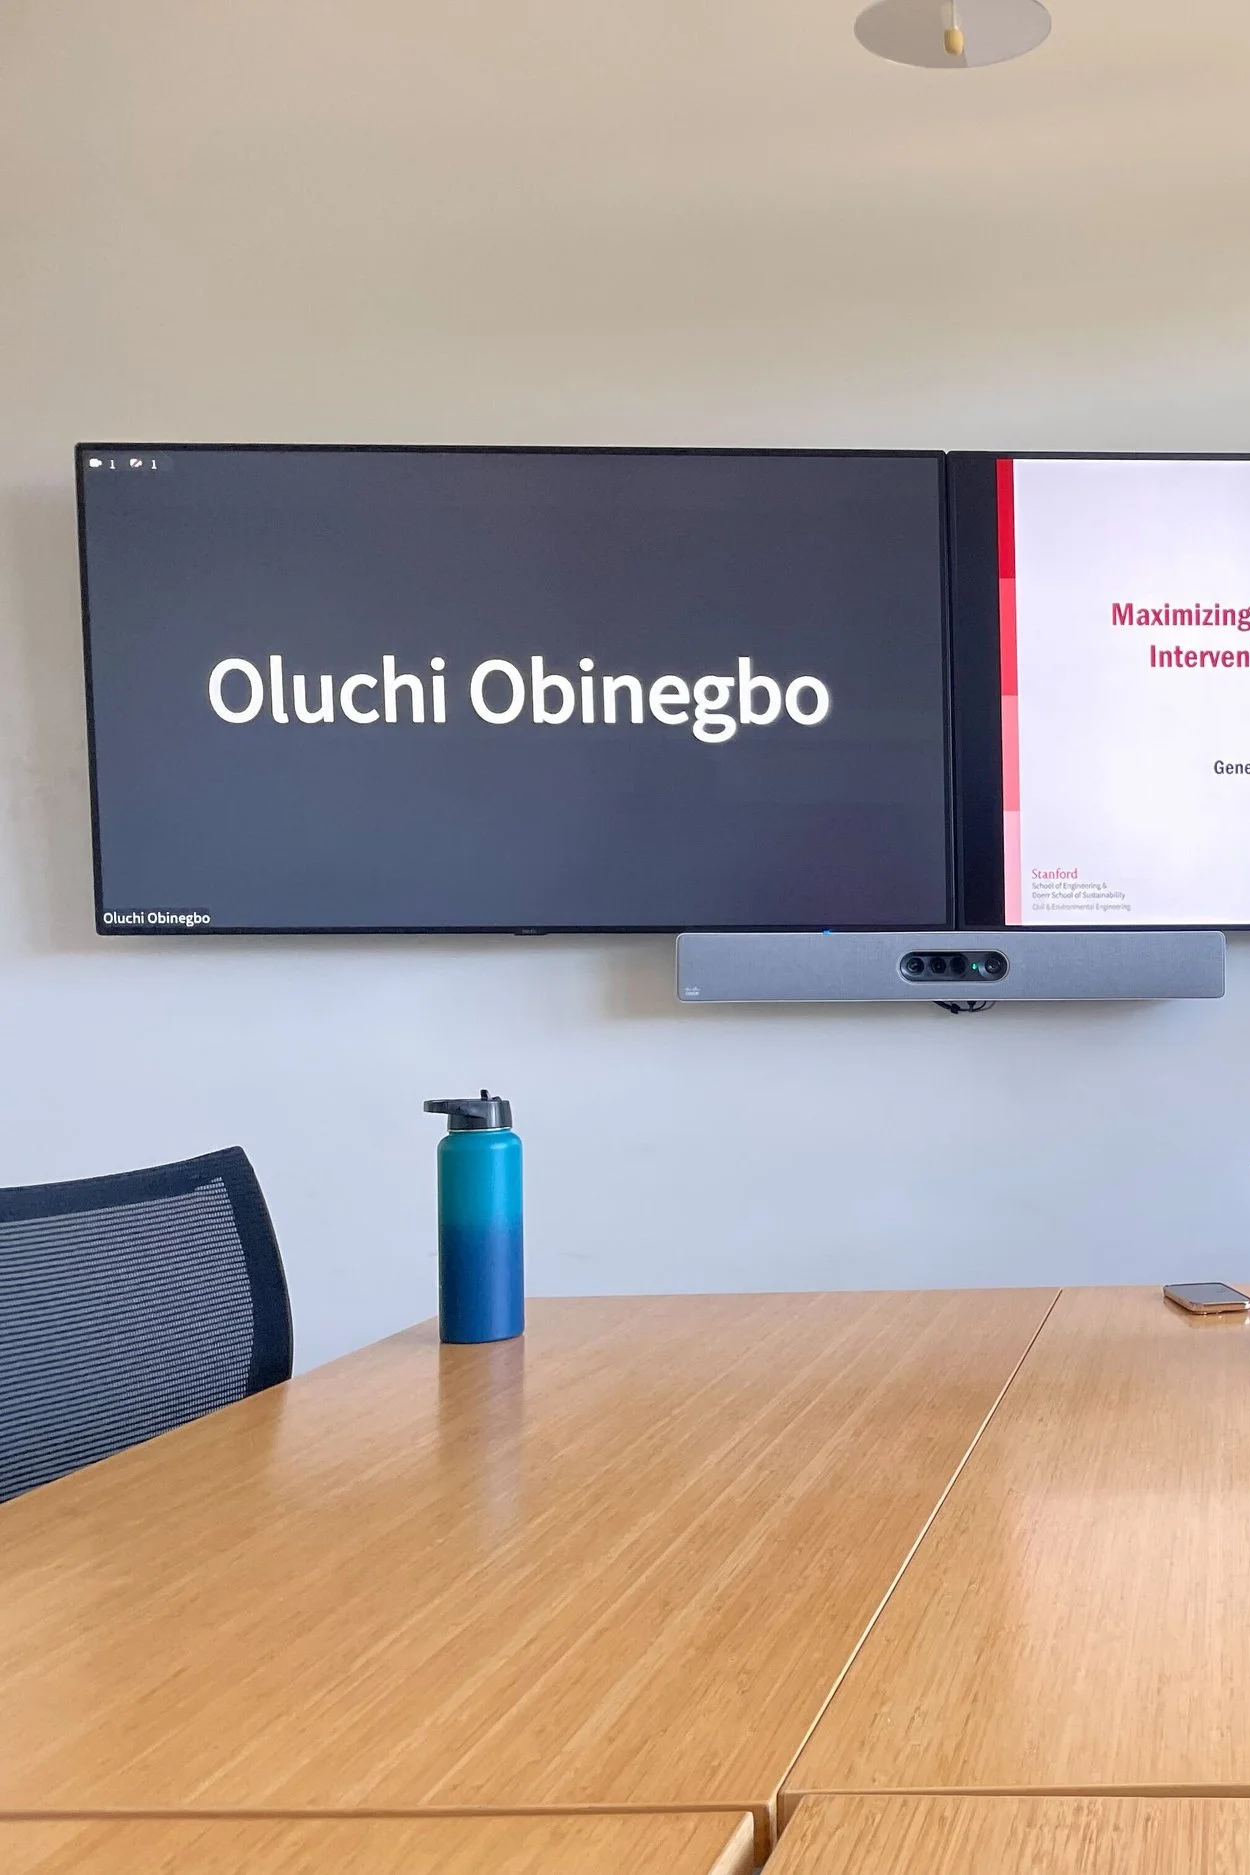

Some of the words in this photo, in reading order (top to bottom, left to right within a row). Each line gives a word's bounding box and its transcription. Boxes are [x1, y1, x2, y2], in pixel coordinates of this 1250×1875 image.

[110, 459, 116, 470] 1
[151, 459, 158, 470] 1
[208, 654, 446, 724] Oluchi
[470, 655, 830, 744] Obinegbo
[1032, 868, 1078, 880] Stanford
[1032, 882, 1054, 890] School
[1063, 882, 1102, 891] Engineering
[1052, 891, 1074, 899] School
[1074, 891, 1082, 899] of
[1083, 891, 1126, 900] Sustainability
[103, 911, 145, 924] Oluchi
[147, 911, 211, 927] Obinegbo
